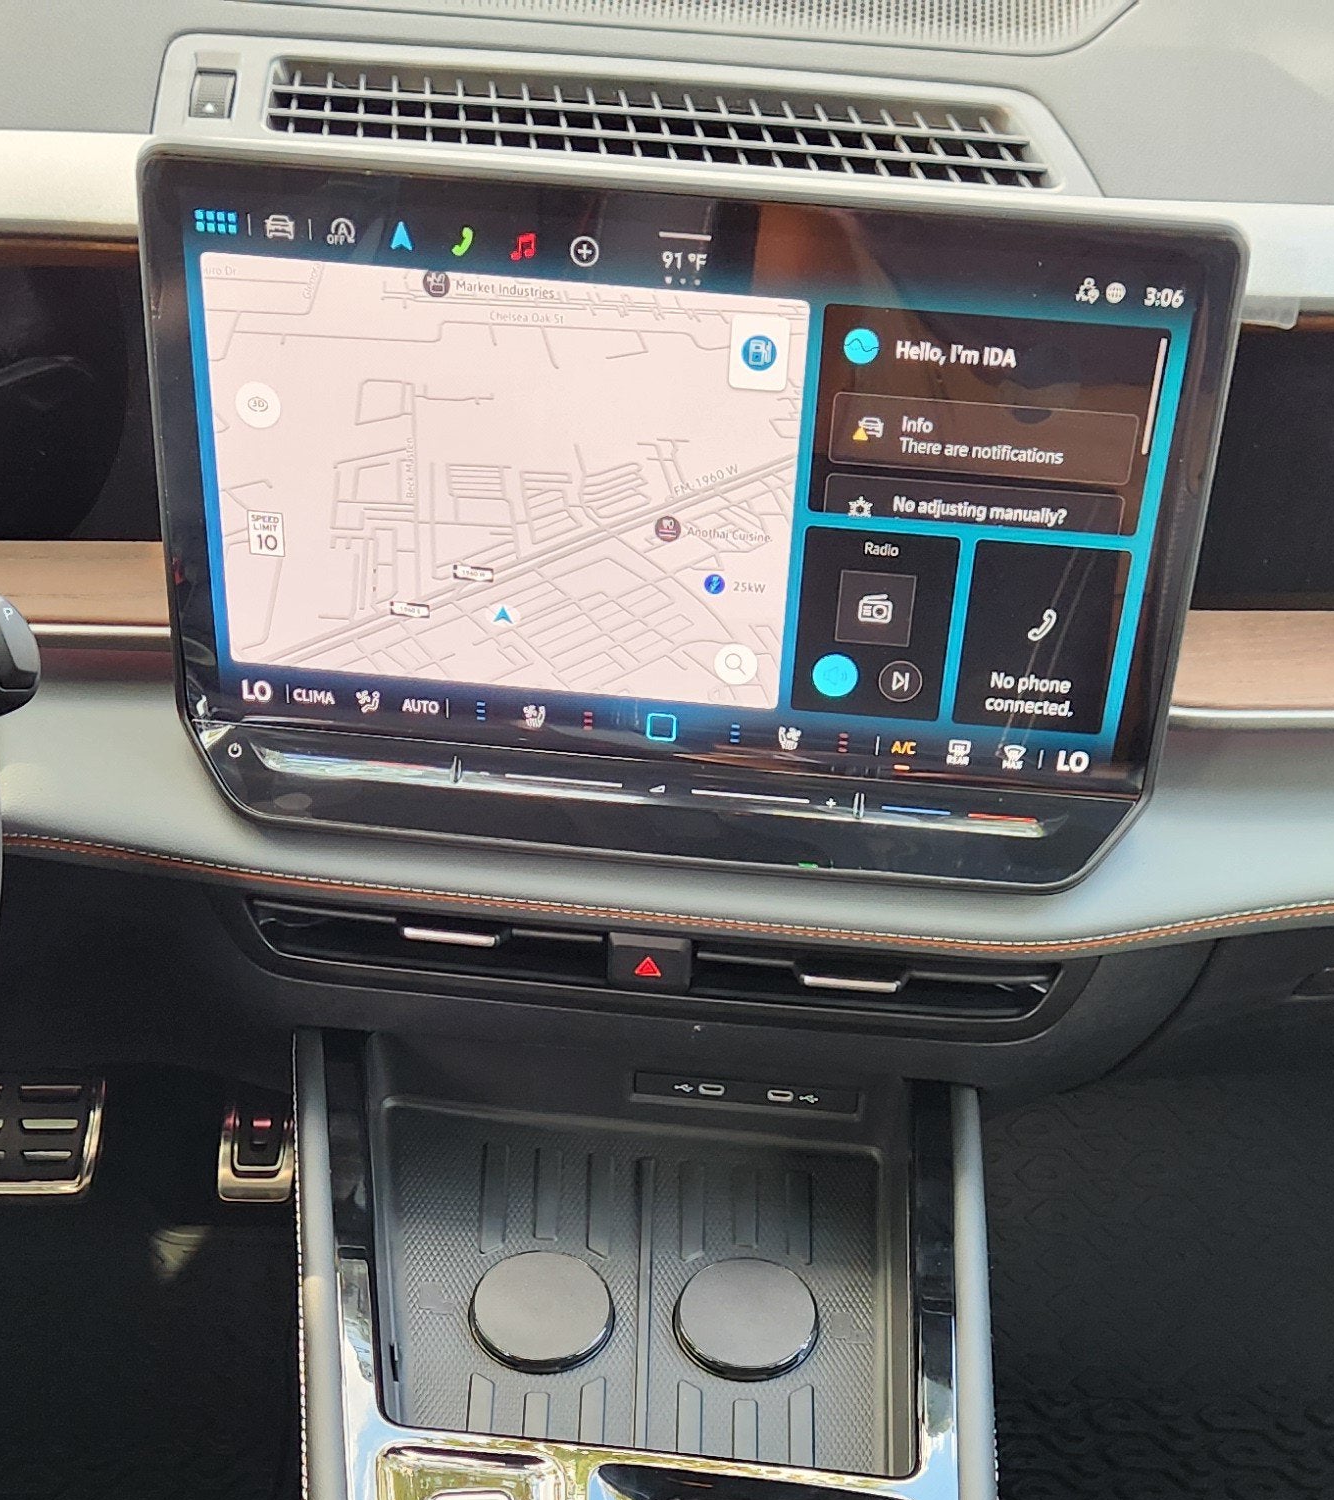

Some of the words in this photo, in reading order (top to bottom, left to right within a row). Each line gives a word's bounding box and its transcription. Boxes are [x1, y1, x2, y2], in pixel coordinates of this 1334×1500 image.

[662, 251, 683, 269] 91
[455, 279, 495, 295] Market
[498, 283, 556, 300] Industries
[1144, 286, 1185, 308] 3:06
[489, 310, 529, 324] Chelsea
[531, 312, 552, 324] Oak
[553, 312, 565, 324] St
[895, 339, 946, 365] Hello,
[950, 342, 979, 365] I'm
[983, 345, 1017, 368] IDA
[252, 399, 265, 409] 3D
[901, 415, 934, 434] Info
[899, 436, 942, 456] There
[944, 443, 969, 458] are
[971, 444, 1064, 466] notifications
[696, 469, 725, 488] 1960
[725, 463, 739, 476] W
[251, 513, 280, 524] SPEED
[892, 495, 915, 514] No
[917, 498, 987, 523] adjusting
[989, 503, 1067, 526] manually?
[253, 522, 278, 533] LIMIT
[687, 526, 729, 541] Anothai
[256, 534, 279, 551] 10
[864, 541, 899, 558] Radio
[733, 580, 766, 594] 25kW
[241, 678, 273, 702] LO
[990, 671, 1015, 690] No
[1017, 674, 1072, 694] phone
[293, 688, 336, 706] CLIMA
[402, 698, 440, 715] AUTO
[984, 695, 1074, 718] connected.
[891, 740, 917, 755] A/C
[1056, 749, 1090, 773] LO
